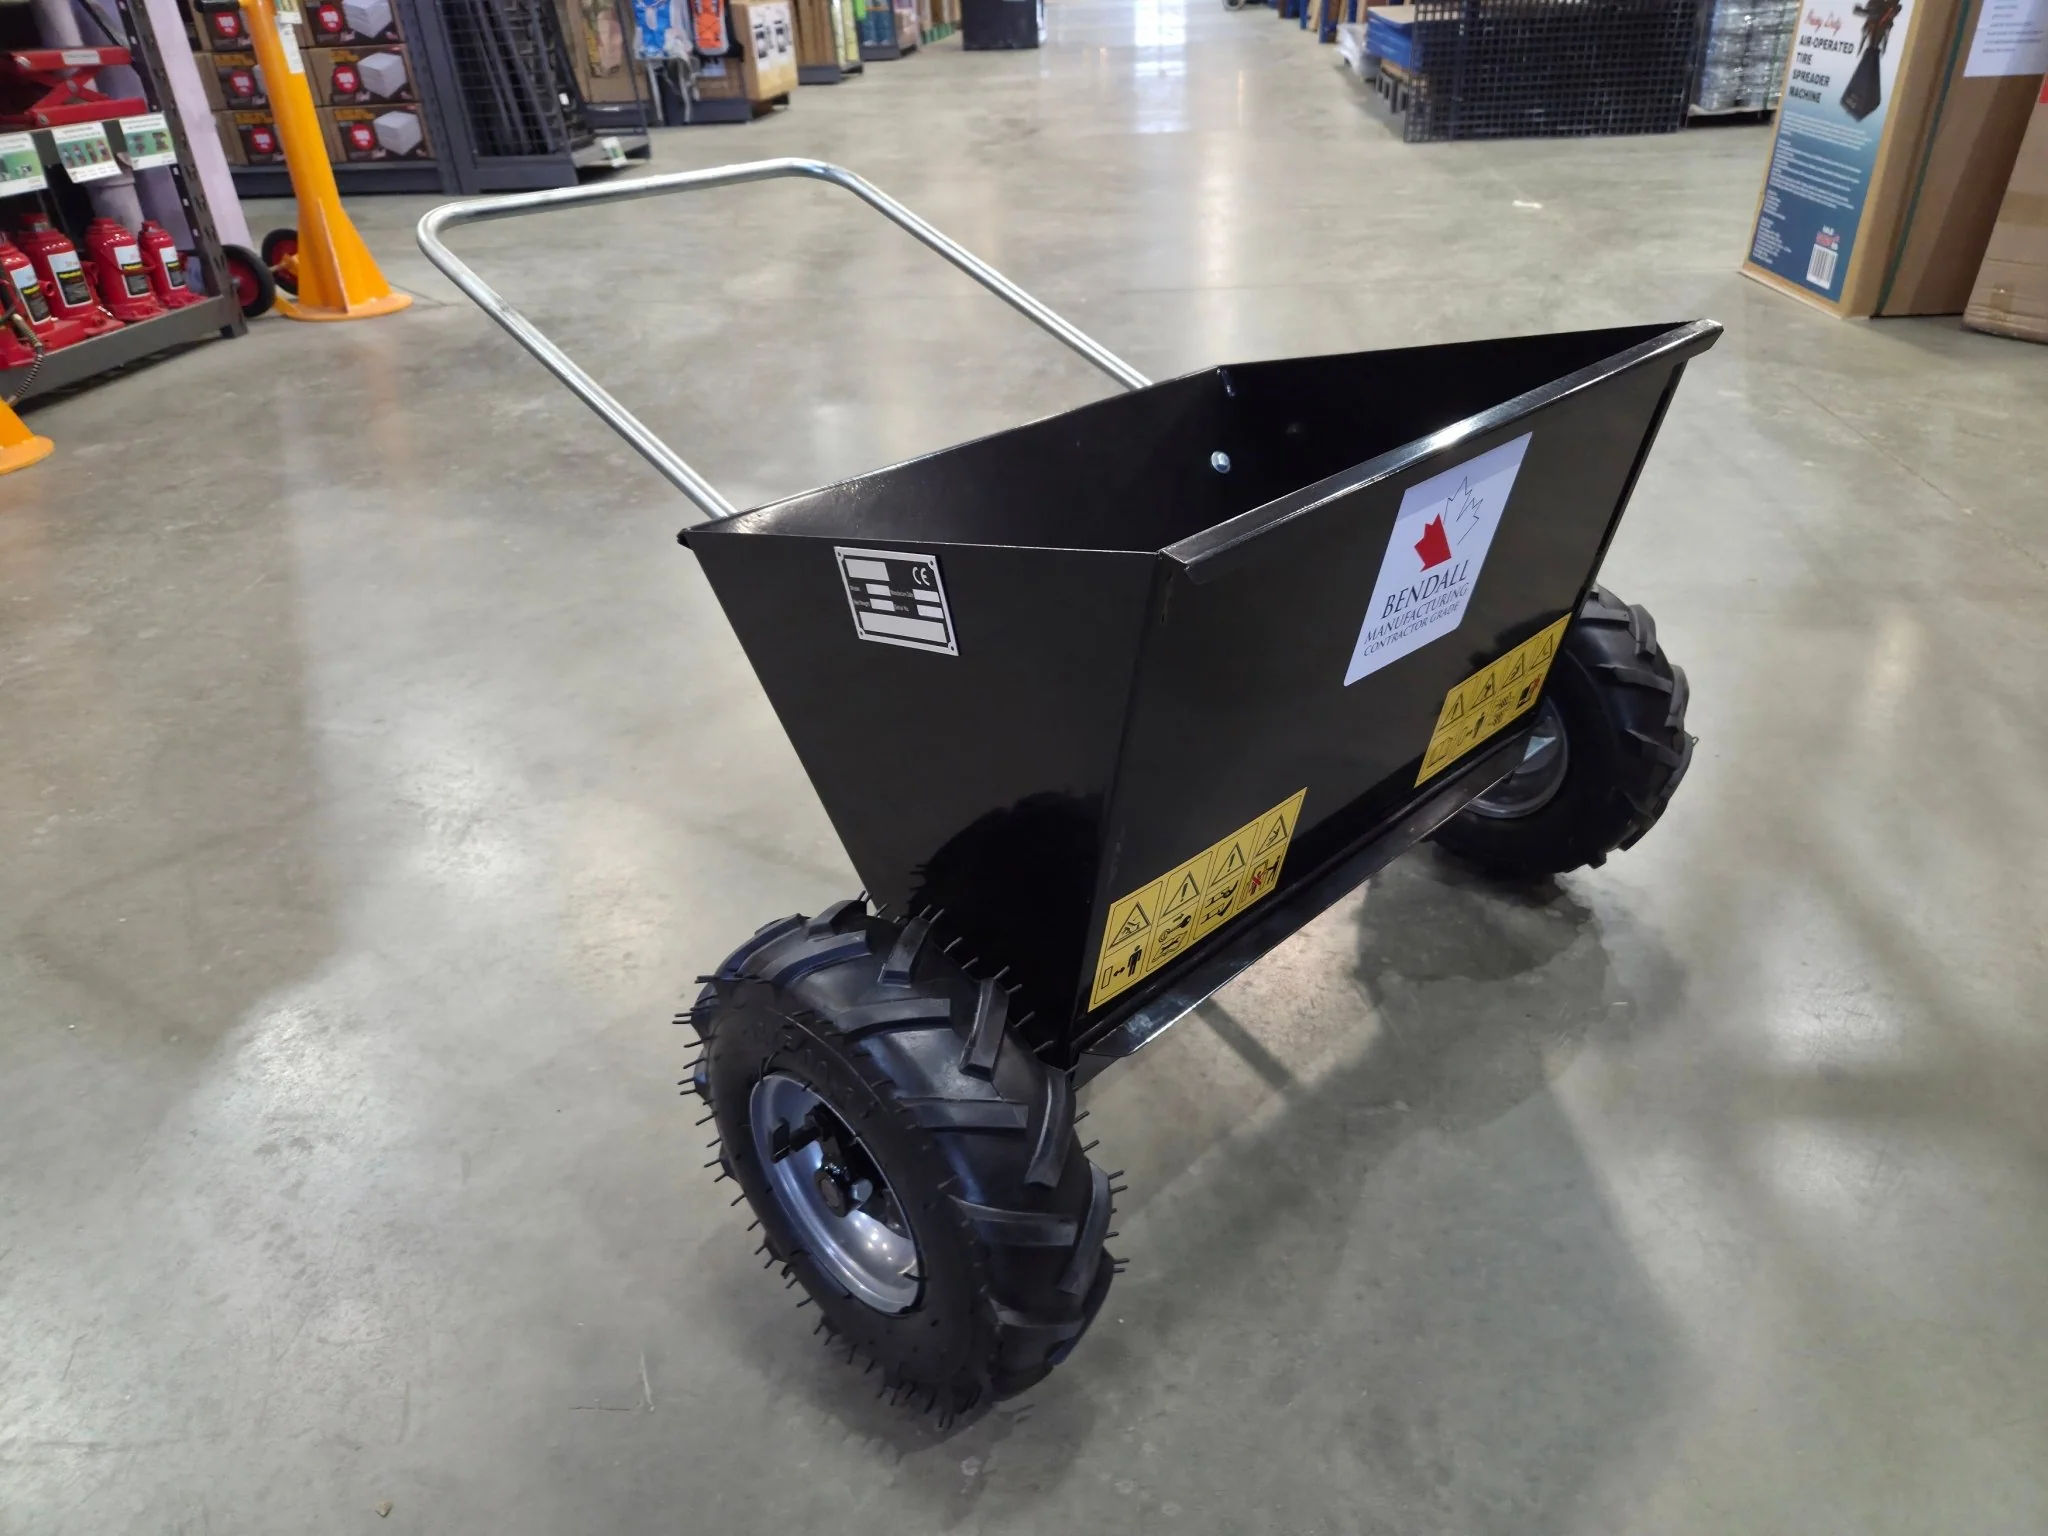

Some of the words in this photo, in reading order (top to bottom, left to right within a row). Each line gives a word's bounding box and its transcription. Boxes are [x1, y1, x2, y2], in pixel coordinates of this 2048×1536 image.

[1800, 35, 1854, 54] AIR-OPERATED
[1797, 52, 1813, 65] TIRE
[1793, 69, 1830, 87] SPREADER
[1789, 86, 1822, 104] MACHINE
[912, 566, 930, 586] CE
[1381, 559, 1469, 620] BENDALL
[1364, 582, 1469, 644] MANUFACTURING
[1363, 618, 1428, 656] CONTRACTOR
[1429, 602, 1459, 623] GRADE
